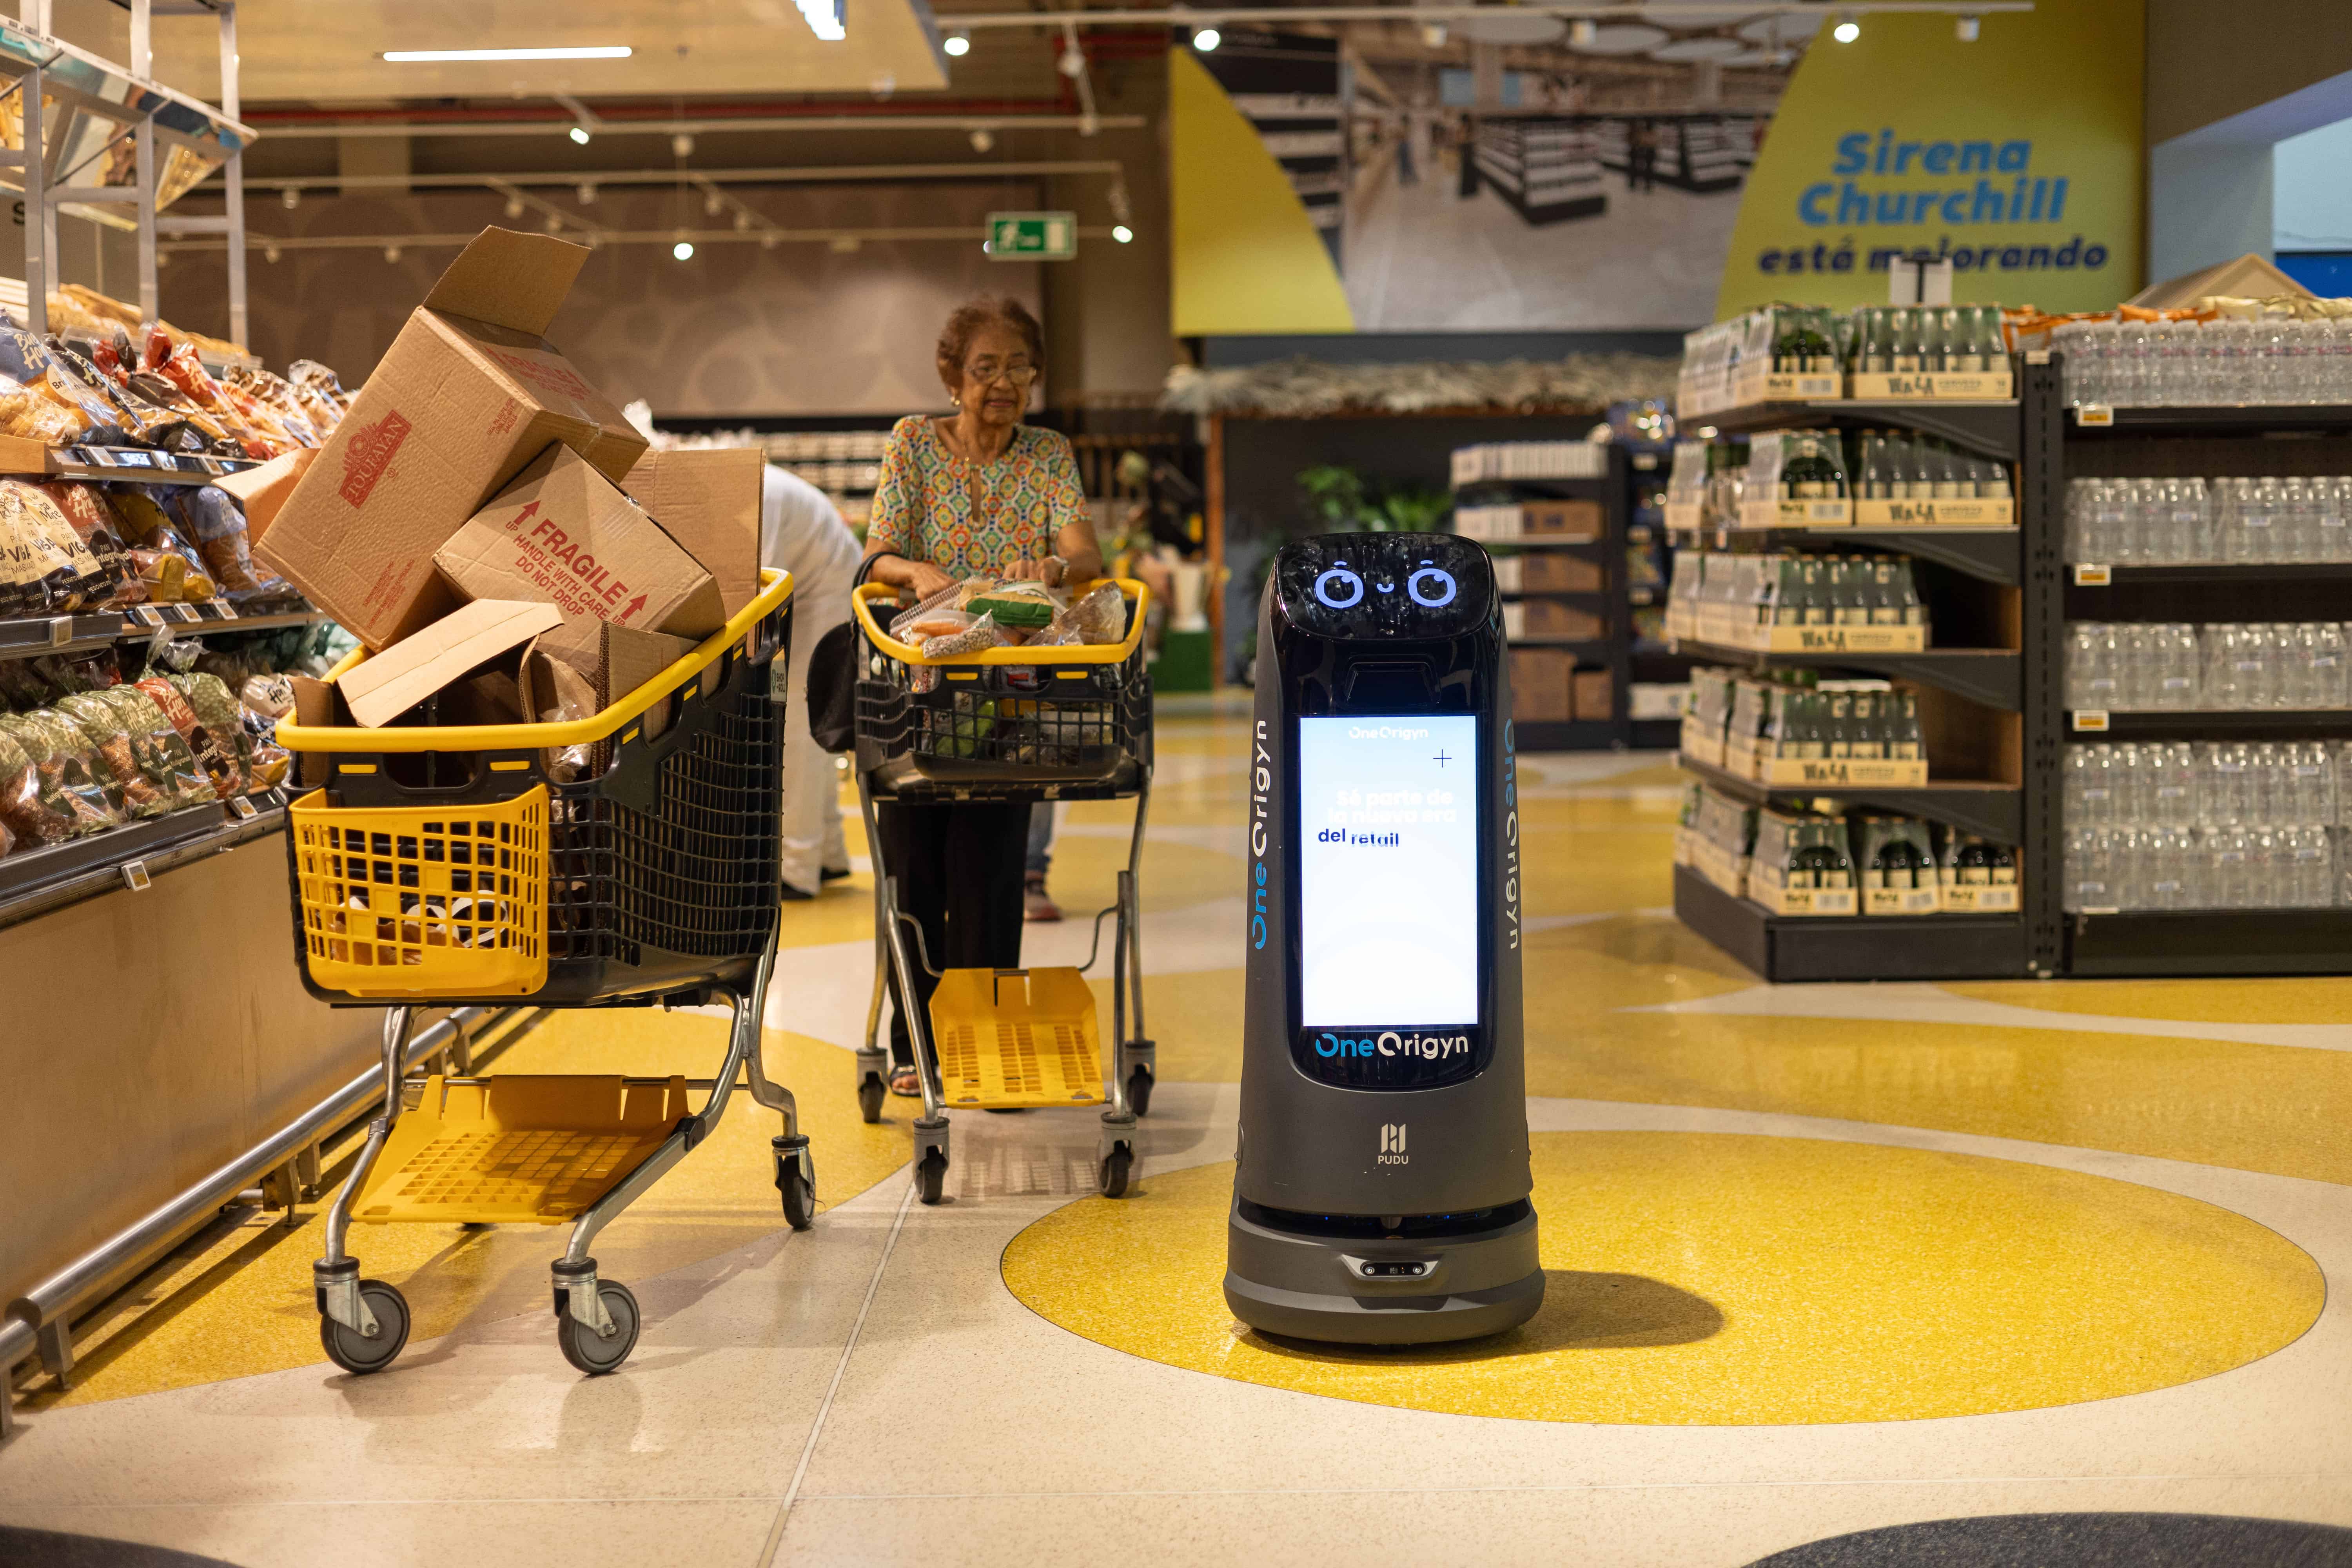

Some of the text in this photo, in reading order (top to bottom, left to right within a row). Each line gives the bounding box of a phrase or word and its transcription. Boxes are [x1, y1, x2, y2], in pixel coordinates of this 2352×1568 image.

[1833, 129, 2032, 176] Sirena
[1798, 177, 2069, 226] Churchill
[1759, 234, 1856, 273] está
[347, 418, 403, 497] TOUFAYAN
[505, 521, 518, 531] UP
[60, 541, 89, 558] VIG
[100, 544, 110, 552] PAN
[531, 518, 629, 606] FRAGILE
[513, 534, 610, 621] HANDLE WITH CARE
[515, 556, 585, 615] DO NOT DROP
[612, 615, 626, 626] UP
[201, 738, 212, 748] PAN
[1349, 726, 1428, 740] OneOrigyn
[44, 780, 57, 793] PAN
[70, 775, 82, 785] PAN
[1336, 788, 1453, 813] Sé parte de
[1327, 807, 1348, 824] la
[1422, 809, 1457, 823] era
[1252, 720, 1270, 950] OneOrigyn
[1318, 828, 1399, 847] del retail
[1504, 718, 1518, 949] OneOrigyn
[1315, 1032, 1468, 1059] OneOrigyn
[1377, 1155, 1408, 1164] PUDU
